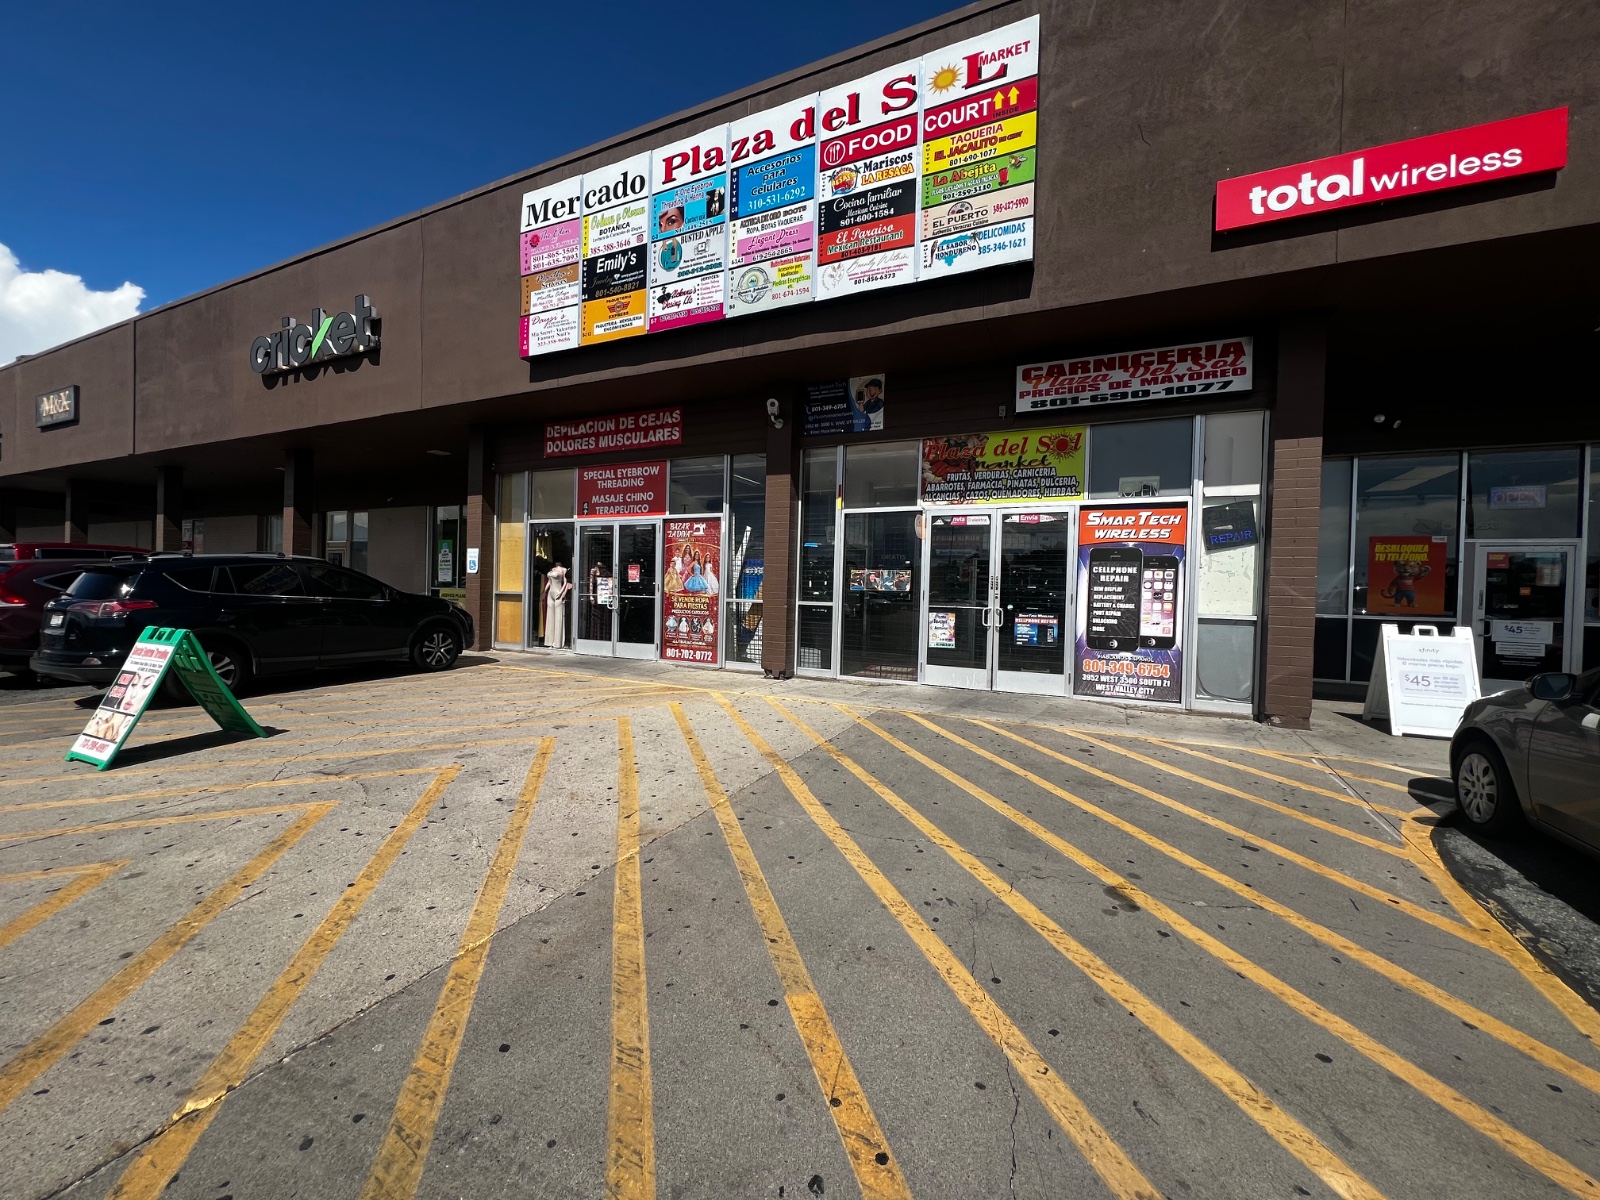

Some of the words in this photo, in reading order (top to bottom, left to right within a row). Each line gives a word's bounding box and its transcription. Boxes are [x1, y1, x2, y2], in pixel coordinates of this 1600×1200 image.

[980, 41, 1031, 68] MARKET
[848, 124, 912, 156] FOOD
[924, 98, 992, 132] COURT
[993, 106, 1019, 119] INSIDE
[951, 124, 1003, 145] TAQUERIA
[934, 150, 946, 161] EL
[947, 136, 998, 158] JACALITO
[950, 148, 997, 166] 801-690-1077
[526, 170, 647, 227] Mercado
[661, 129, 777, 185] Plaza
[790, 92, 862, 142] del
[747, 154, 802, 176] Accesorios
[863, 152, 913, 174] Mariscos
[763, 168, 787, 184] para
[861, 173, 875, 186] LA
[876, 163, 914, 182] RESACA
[933, 175, 947, 187] La
[949, 163, 997, 183] Abejita
[1248, 157, 1365, 215] total
[1370, 148, 1523, 193] wireless
[751, 176, 798, 196] Celulares
[748, 186, 806, 211] 310-531-6292
[834, 198, 866, 212] Cocina
[783, 205, 807, 217] BOOTS
[840, 208, 894, 226] 801-600-1584
[933, 217, 945, 229] EL
[948, 208, 988, 224] PUERTO
[600, 222, 630, 236] BOTANICA
[761, 221, 776, 232] BOTAS
[778, 215, 804, 227] VAQUERAS
[978, 222, 1026, 241] DELICOMIDAS
[681, 230, 704, 244] BUSTED
[704, 226, 724, 239] APPLE
[776, 229, 799, 244] Dress
[828, 241, 858, 256] Mexican
[860, 229, 904, 247] Restaurant
[836, 231, 849, 244] El
[851, 224, 893, 241] Paraiso
[946, 239, 968, 250] SABOR
[978, 237, 1026, 255] 385-346-1621
[597, 250, 637, 273] Emily's
[250, 294, 378, 374] cricket
[1021, 341, 1247, 383] CARNICERIA
[1026, 373, 1113, 390] Plaza
[1124, 361, 1178, 379] Del
[1186, 353, 1245, 373] Sol
[1019, 383, 1101, 400] PRECIOS
[1108, 379, 1132, 391] DE
[1140, 367, 1247, 387] MAYOREO
[1030, 380, 1234, 409] 801-690-1077
[546, 418, 616, 438] DEPILACION
[619, 416, 635, 430] DE
[638, 410, 681, 428] CEJAS
[546, 437, 596, 453] DOLORES
[598, 427, 681, 448] MUSCULARES
[924, 441, 986, 462] Plaza
[994, 437, 1028, 457] del
[969, 455, 1052, 471] market
[583, 469, 616, 482] SPECIAL
[617, 465, 660, 479] EYEBROW
[946, 472, 972, 486] FRUTAS,
[974, 469, 1012, 483] VERDURAS,
[1013, 467, 1057, 481] CARNICERIA
[597, 478, 645, 490] THREADING
[926, 482, 967, 493] ABARROTES,
[967, 479, 1005, 491] FARMACIA,
[1041, 475, 1080, 487] DULCERIA,
[592, 493, 624, 504] MASAJE
[626, 491, 655, 503] CHINO
[596, 504, 650, 515] TERAPEUTICO
[670, 522, 691, 531] BAZAR
[1095, 529, 1171, 541] WIRELESS
[1210, 530, 1253, 545] REPAIR
[1375, 544, 1429, 554] DESBLOQUEA
[1376, 553, 1386, 561] TU
[1092, 566, 1138, 574] CELLPHONE
[1099, 575, 1129, 583] REPAIR
[666, 648, 713, 661] 801-702-0772
[1083, 659, 1171, 679] 801-349-6754
[1081, 673, 1099, 682] 3952
[1100, 674, 1119, 684] WEST
[1139, 677, 1161, 687] SOUTH
[1095, 683, 1113, 691] WEST
[1114, 684, 1137, 694] VALLEY
[1138, 686, 1155, 695] CITY
[1404, 673, 1431, 688] $45
